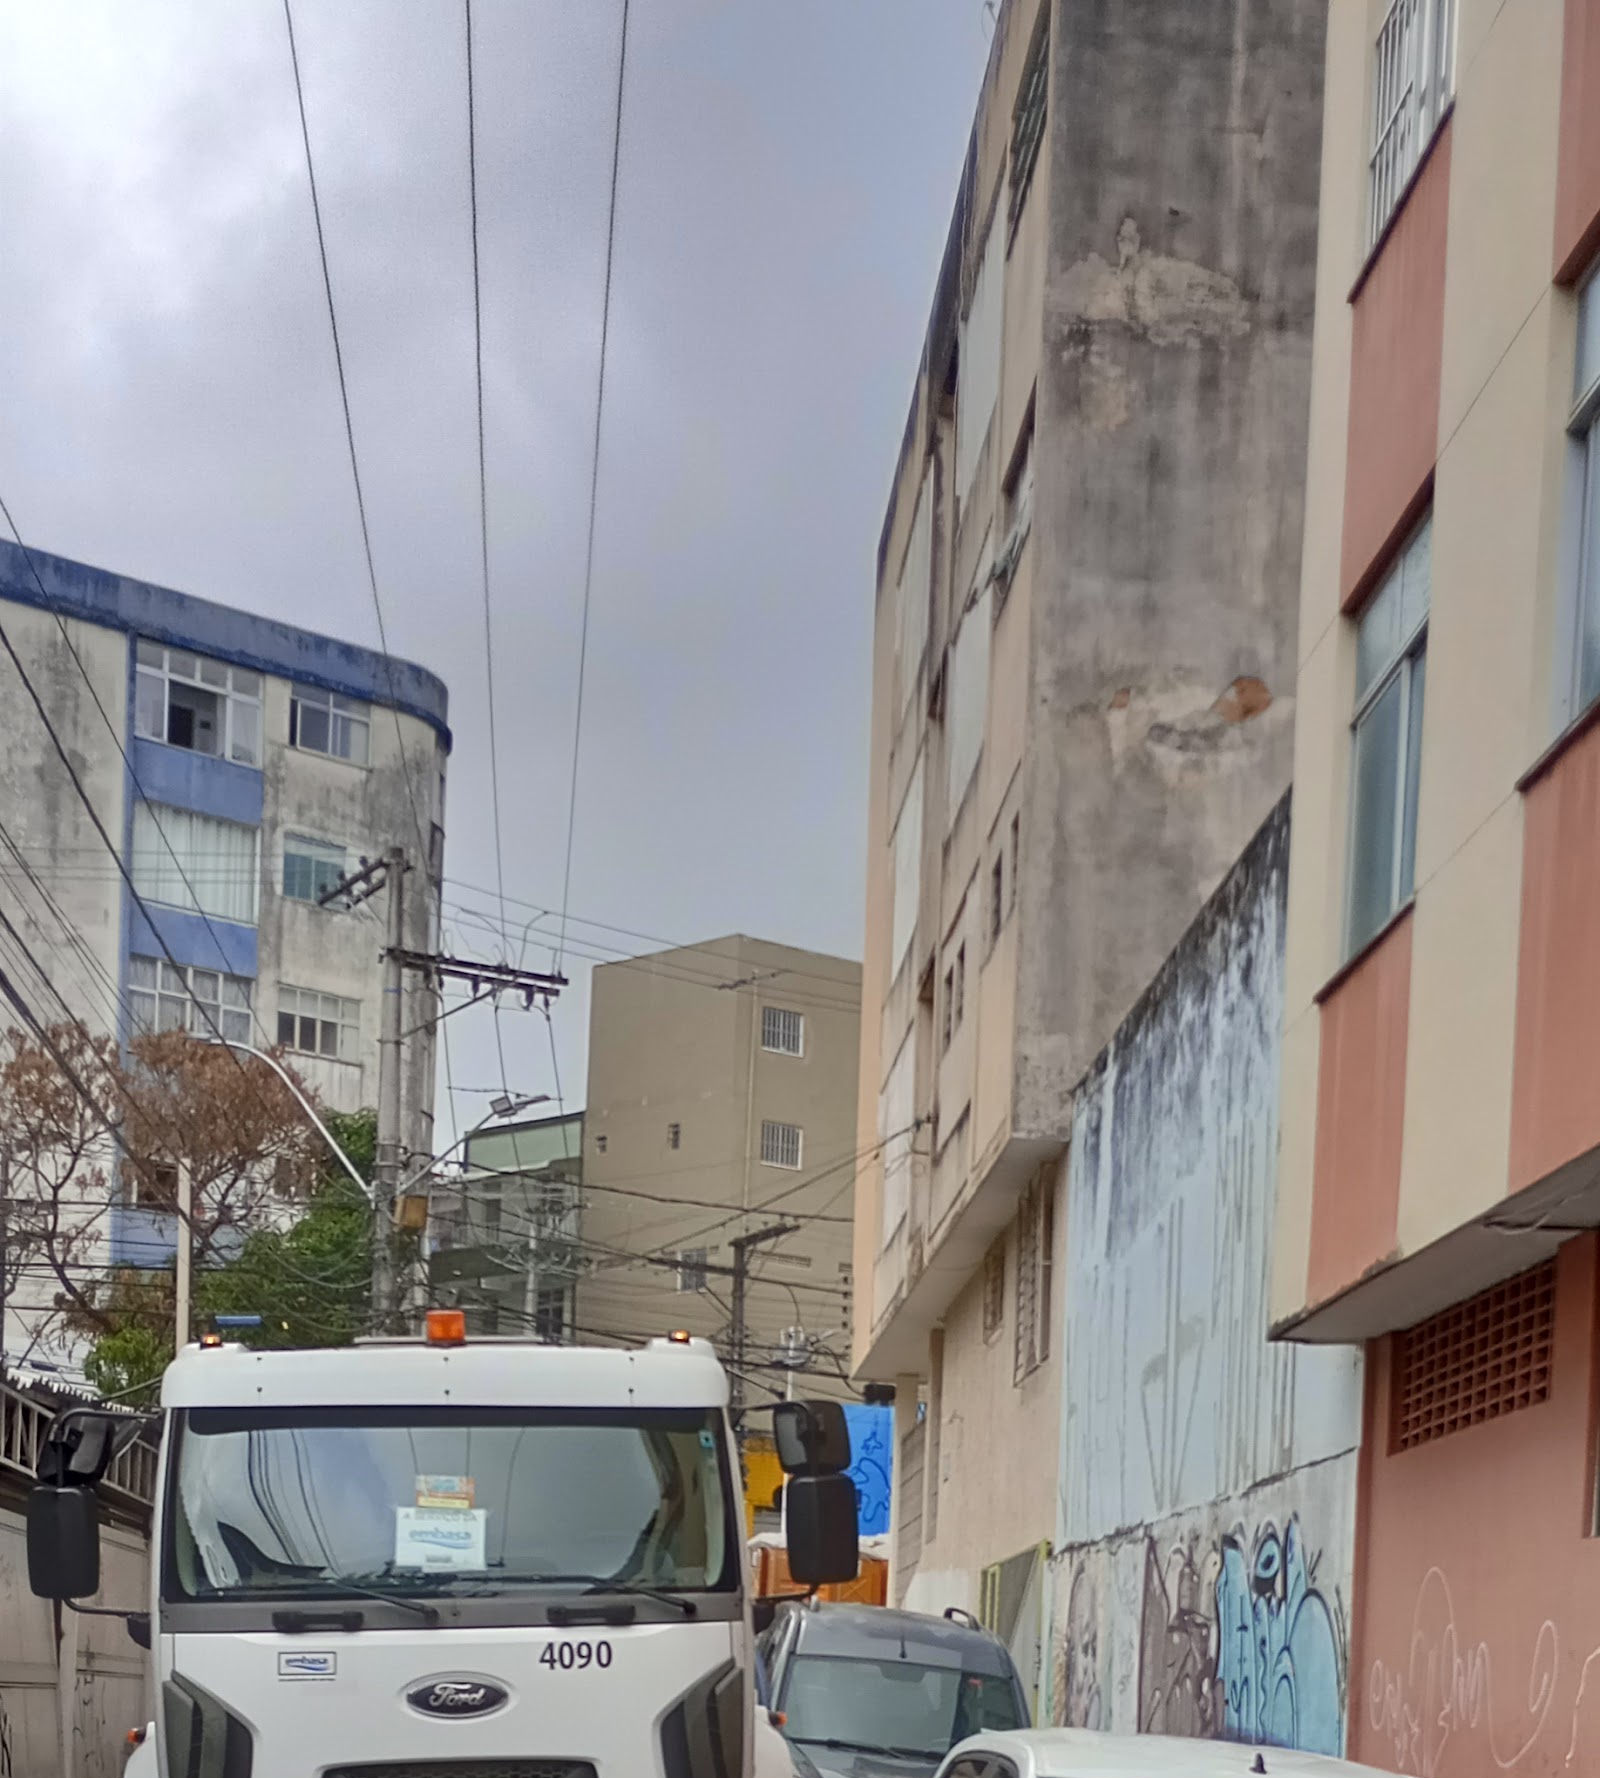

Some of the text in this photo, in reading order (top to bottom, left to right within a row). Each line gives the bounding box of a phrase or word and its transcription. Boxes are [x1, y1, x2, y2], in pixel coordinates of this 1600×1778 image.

[409, 1527, 471, 1541] embasa
[539, 1640, 613, 1670] 4090
[429, 1683, 486, 1706] Ford
